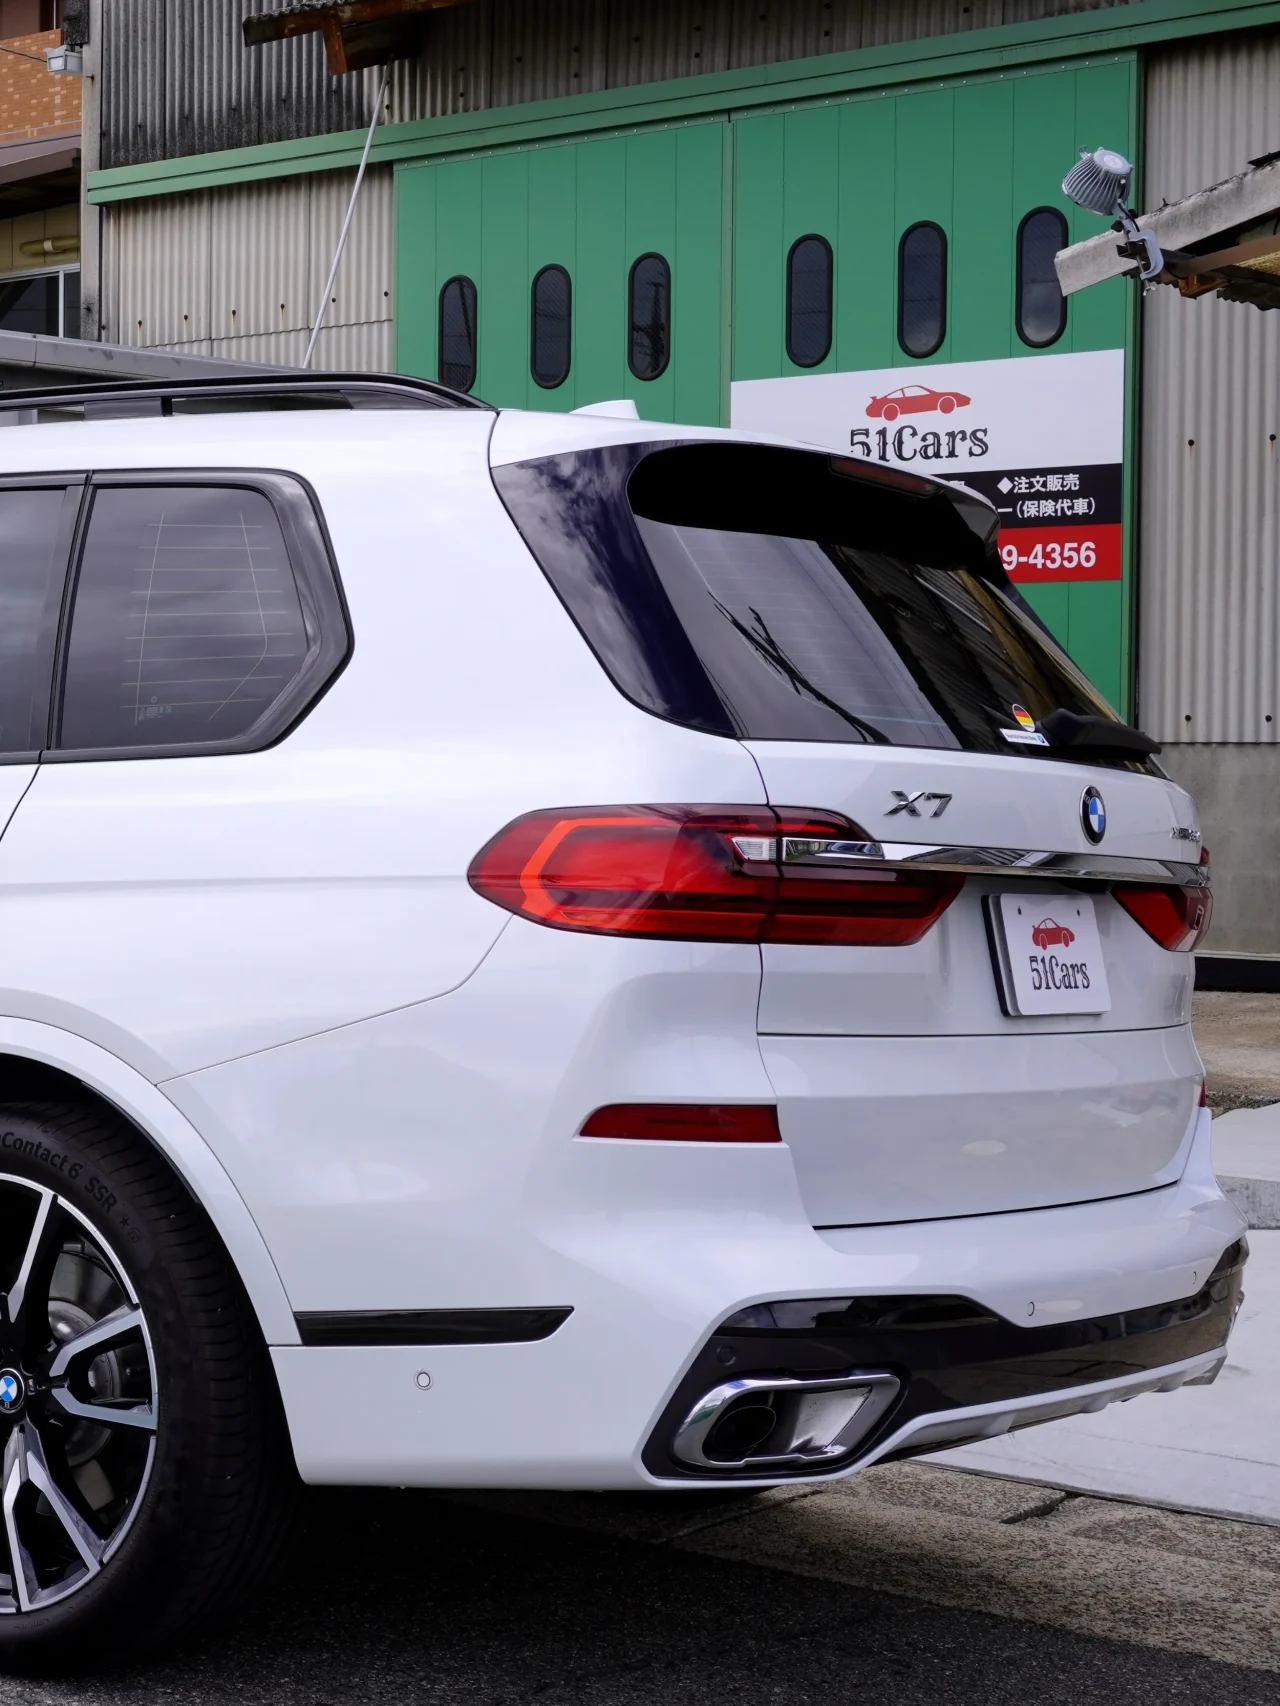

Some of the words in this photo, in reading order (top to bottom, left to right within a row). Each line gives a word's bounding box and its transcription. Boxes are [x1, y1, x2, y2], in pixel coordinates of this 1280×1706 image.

[851, 425, 988, 461] 51Cars
[1013, 474, 1080, 493] 注文販売
[998, 542, 1096, 570] 9-4356
[884, 790, 952, 817] X7
[1029, 955, 1090, 991] 51Cars
[67, 1163, 83, 1179] 6
[84, 1177, 117, 1213] SSR
